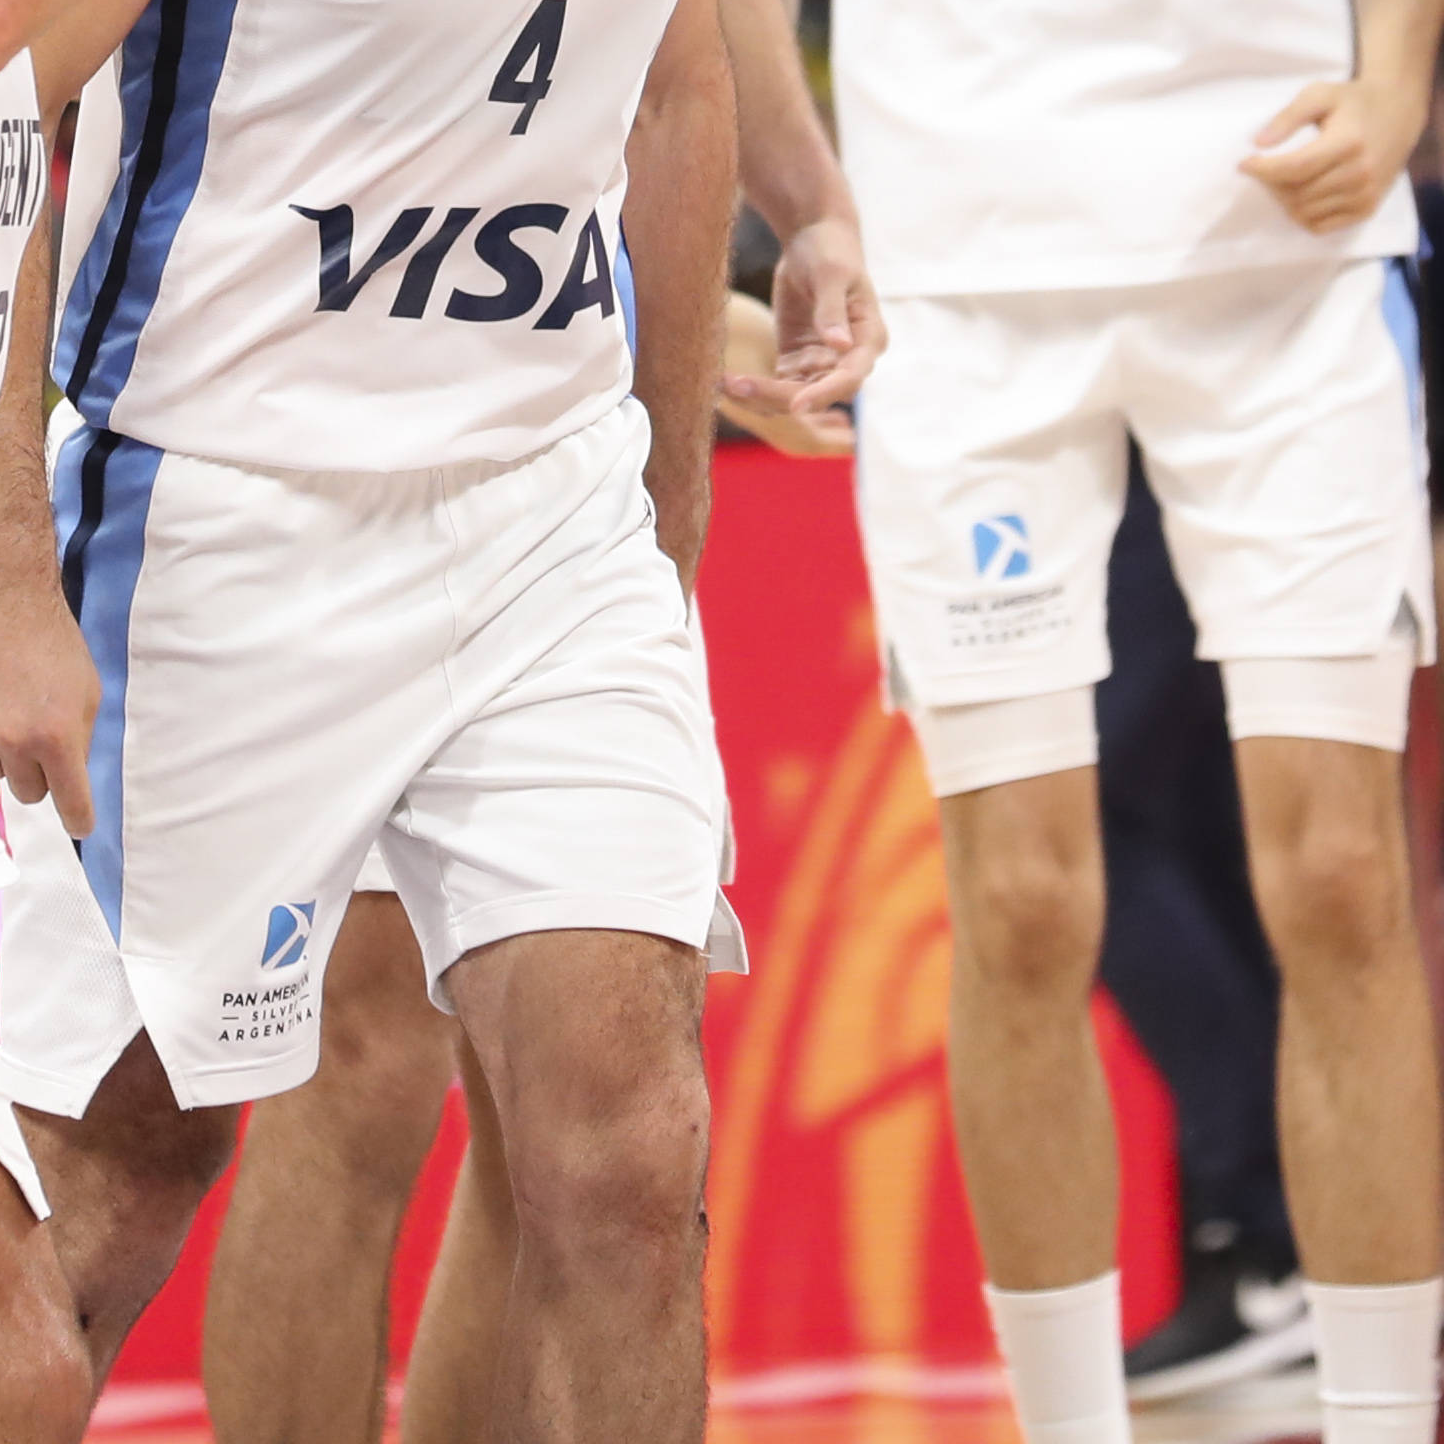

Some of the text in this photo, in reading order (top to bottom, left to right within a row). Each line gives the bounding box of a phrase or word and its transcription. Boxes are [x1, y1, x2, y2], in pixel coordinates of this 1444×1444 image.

[487, 0, 568, 136] 4
[288, 203, 616, 330] VISA
[218, 1008, 313, 1041] ARGENTINA
[223, 992, 257, 1008] PAN
